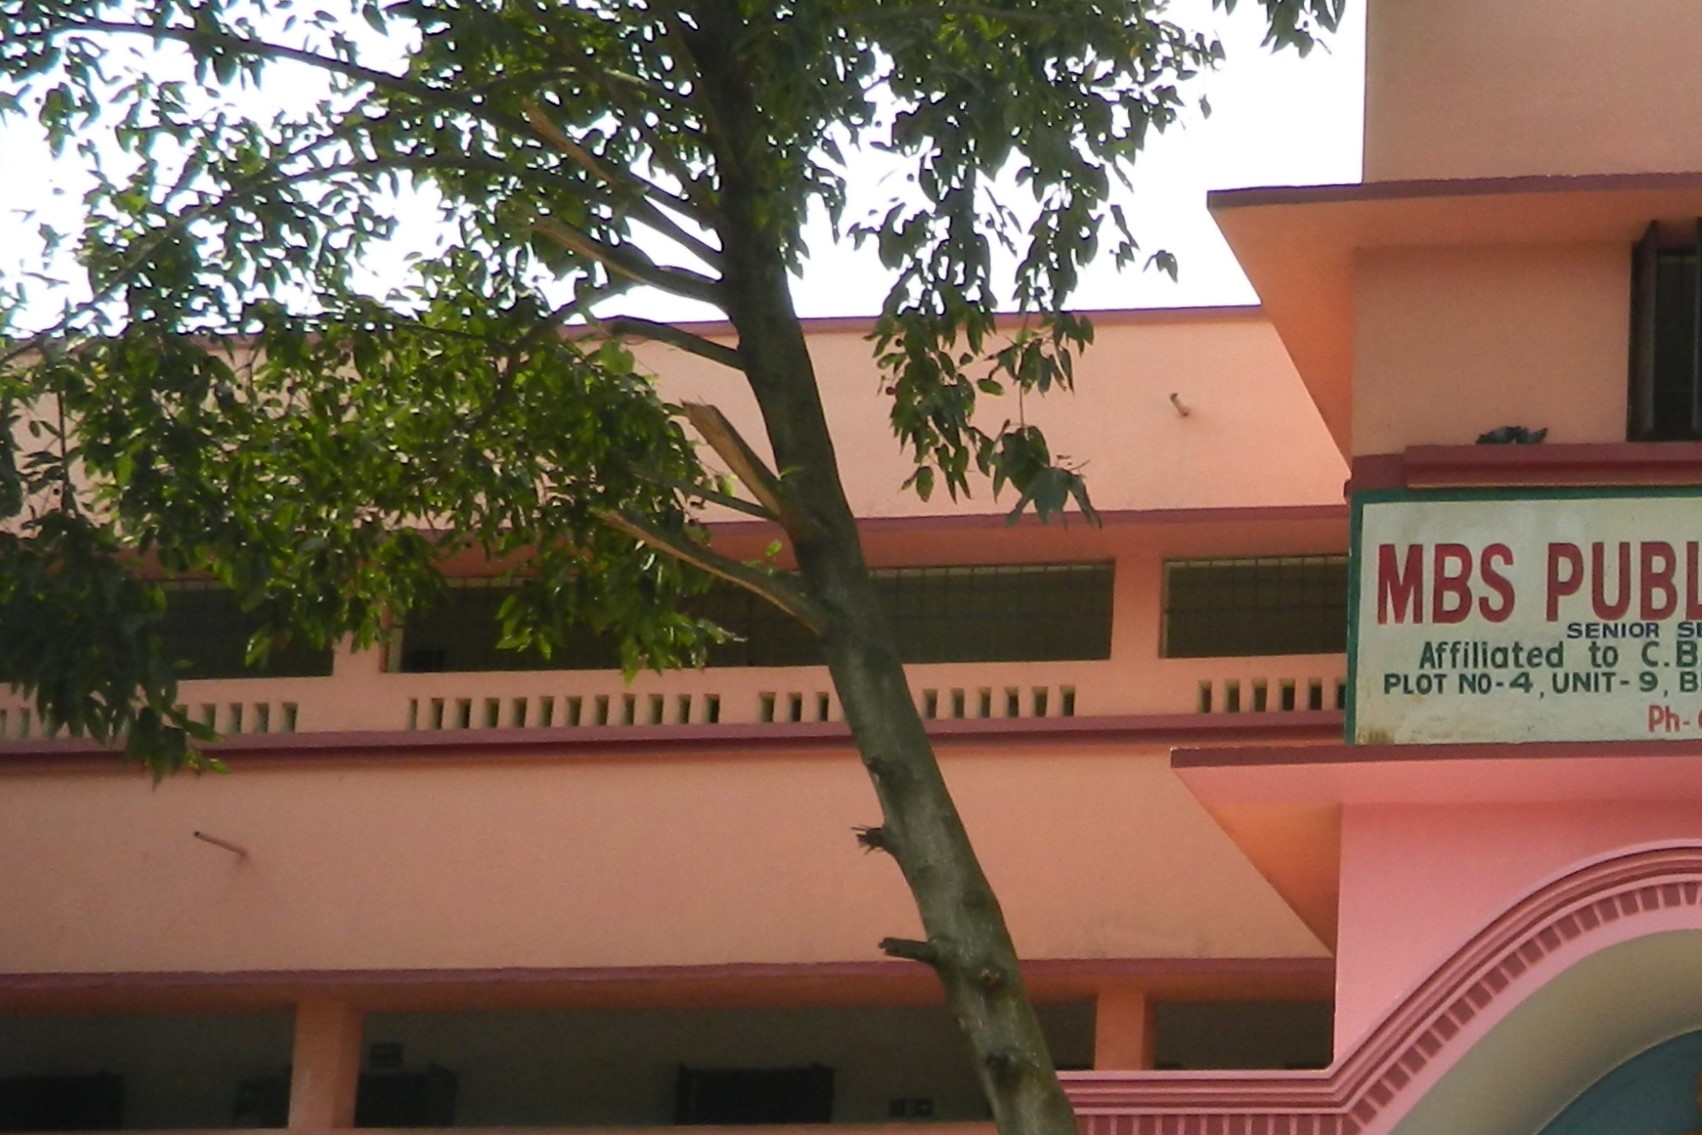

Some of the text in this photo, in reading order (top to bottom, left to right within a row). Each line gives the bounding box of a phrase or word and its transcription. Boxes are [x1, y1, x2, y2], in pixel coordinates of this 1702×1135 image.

[1377, 543, 1515, 625] MBS
[1567, 622, 1660, 639] SENIOR
[1419, 640, 1565, 669] Affiliated
[1588, 642, 1620, 669] to
[1383, 672, 1447, 695] PLOT
